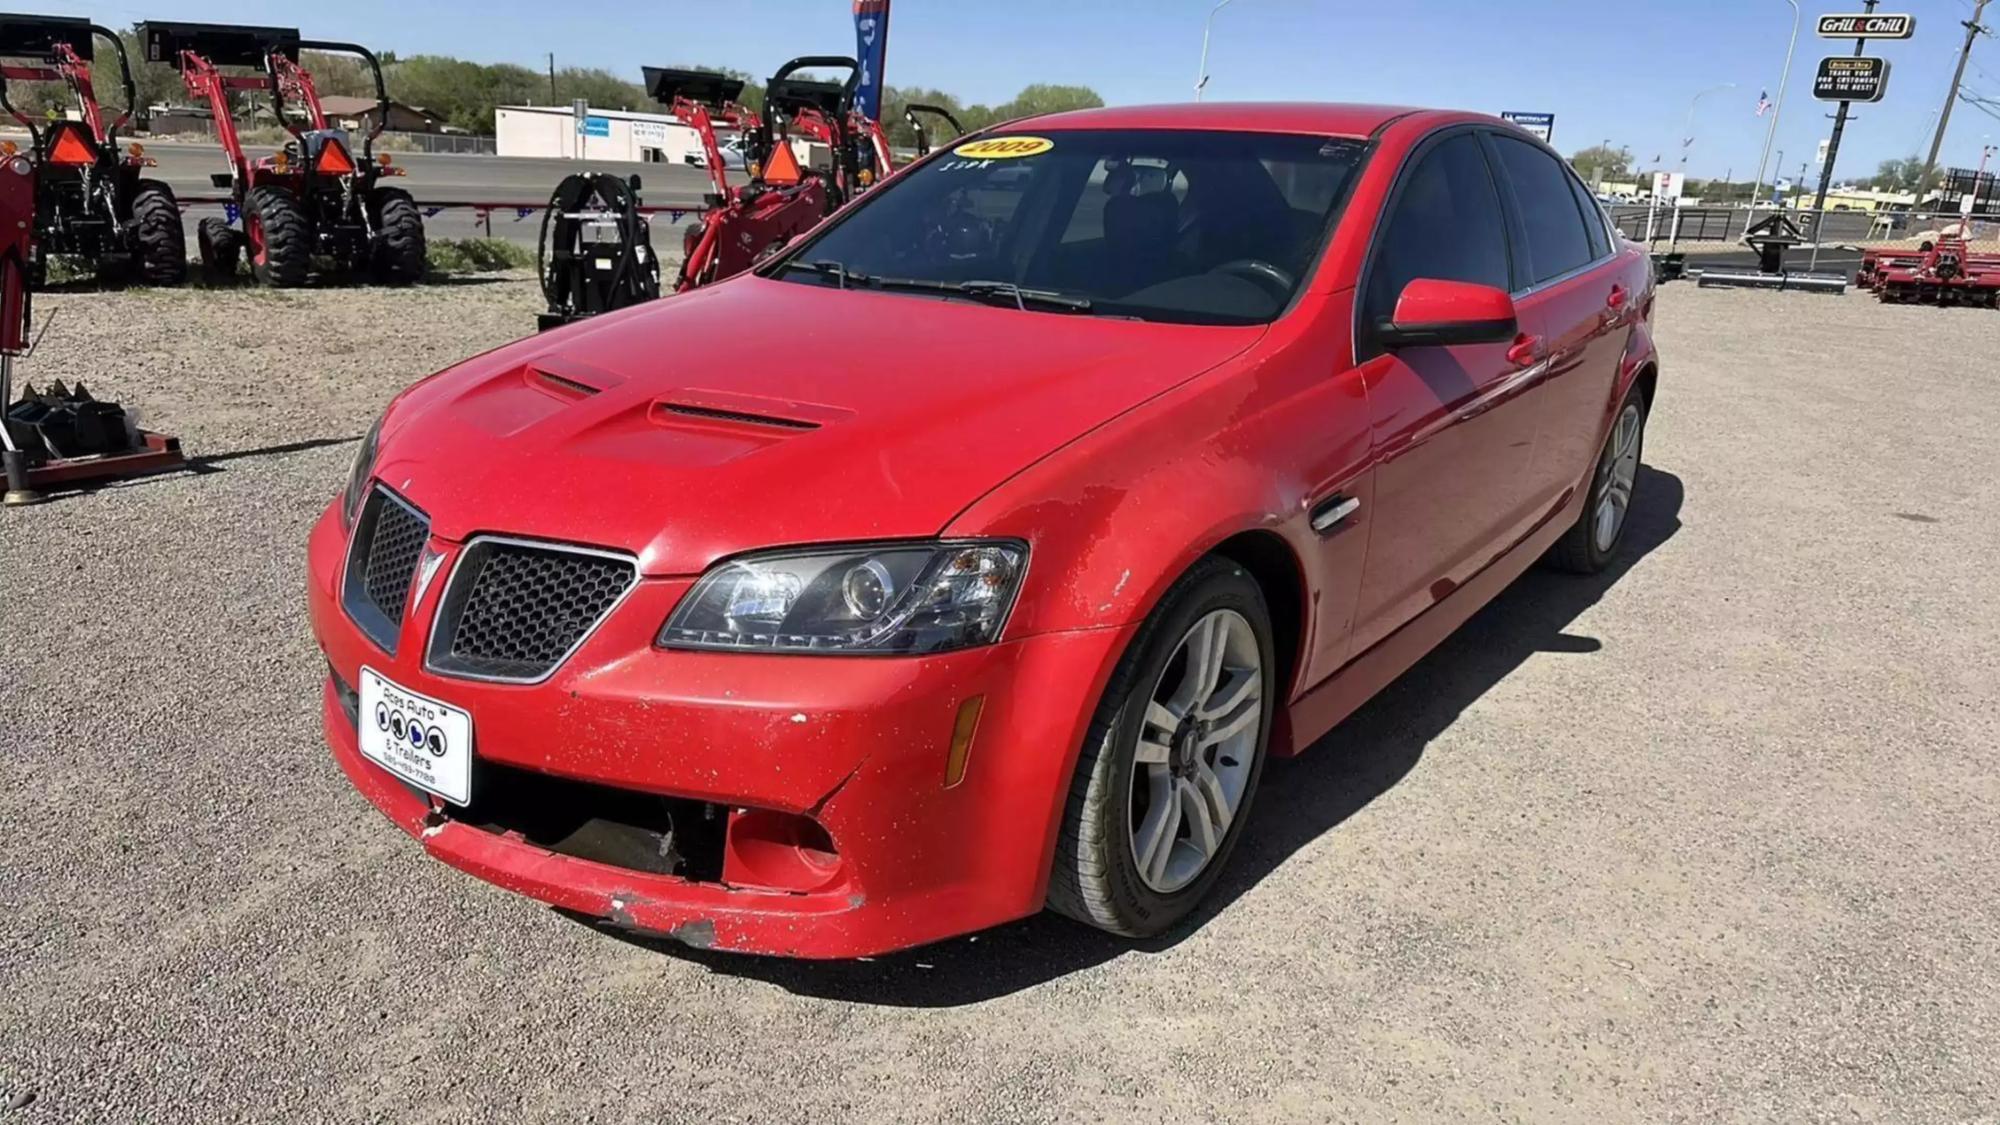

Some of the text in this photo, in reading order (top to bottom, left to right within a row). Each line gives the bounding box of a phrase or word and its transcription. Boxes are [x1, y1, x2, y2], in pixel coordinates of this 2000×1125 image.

[959, 141, 1044, 153] 2009
[383, 687, 435, 720] Aces Auto
[393, 741, 432, 770] Trailers
